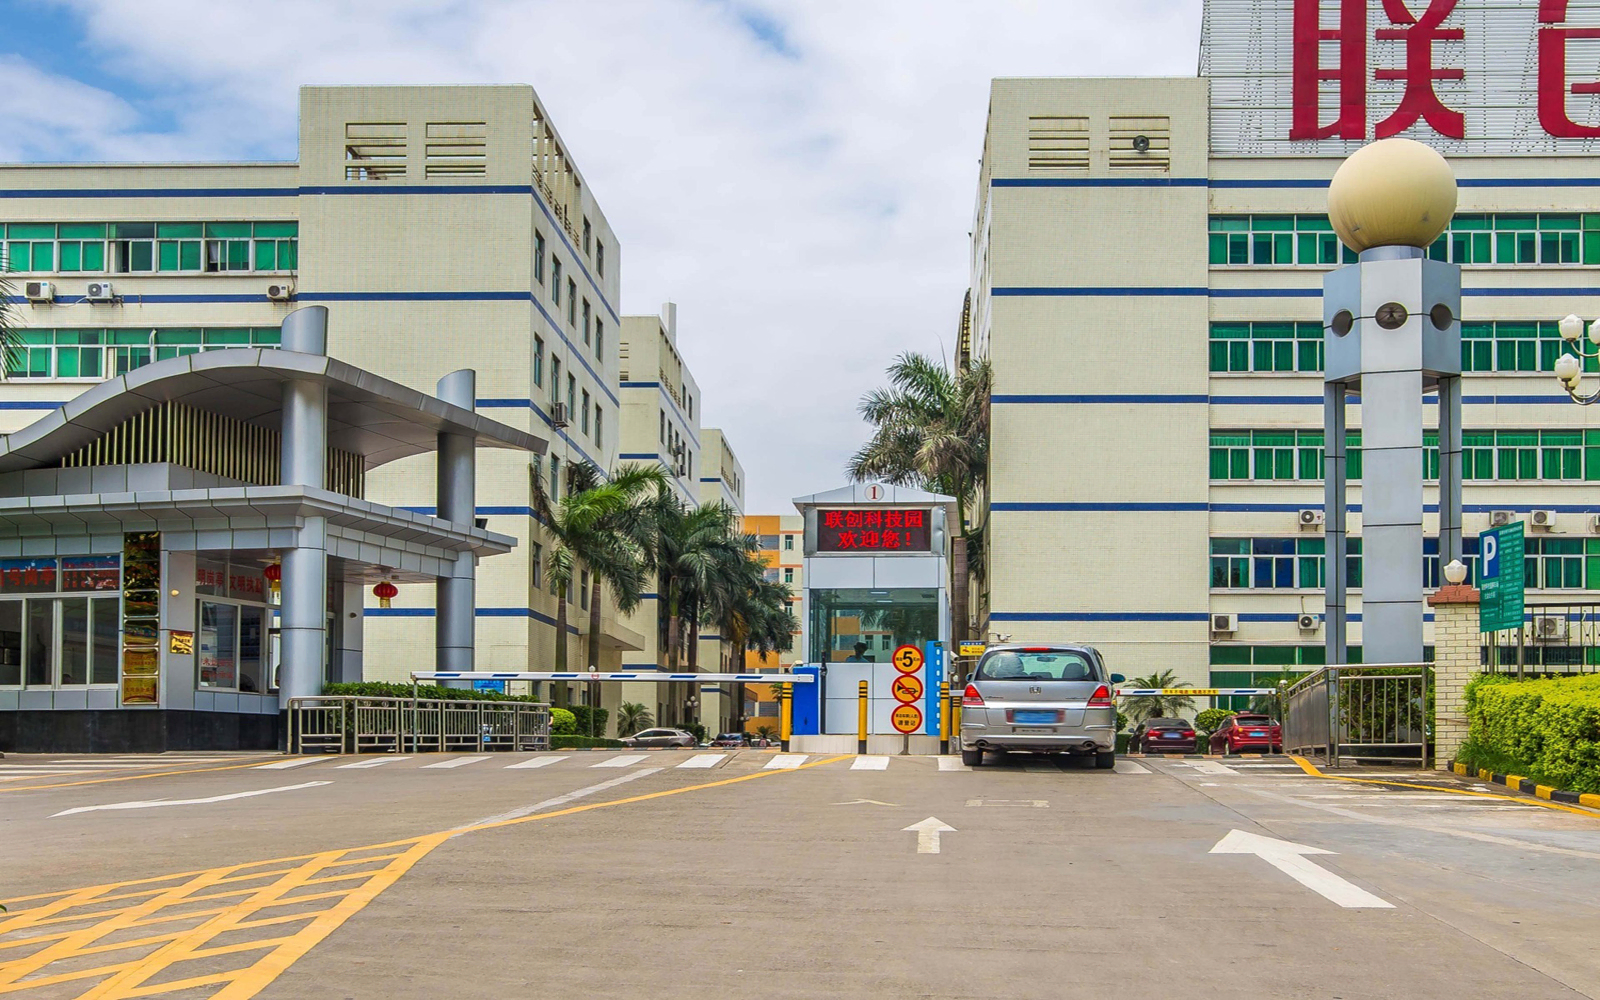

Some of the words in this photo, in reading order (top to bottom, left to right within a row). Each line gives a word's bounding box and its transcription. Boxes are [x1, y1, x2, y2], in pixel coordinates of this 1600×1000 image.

[871, 486, 877, 500] 1
[824, 510, 923, 529] 联创科技园
[1483, 535, 1497, 577] P
[902, 651, 913, 667] 5
